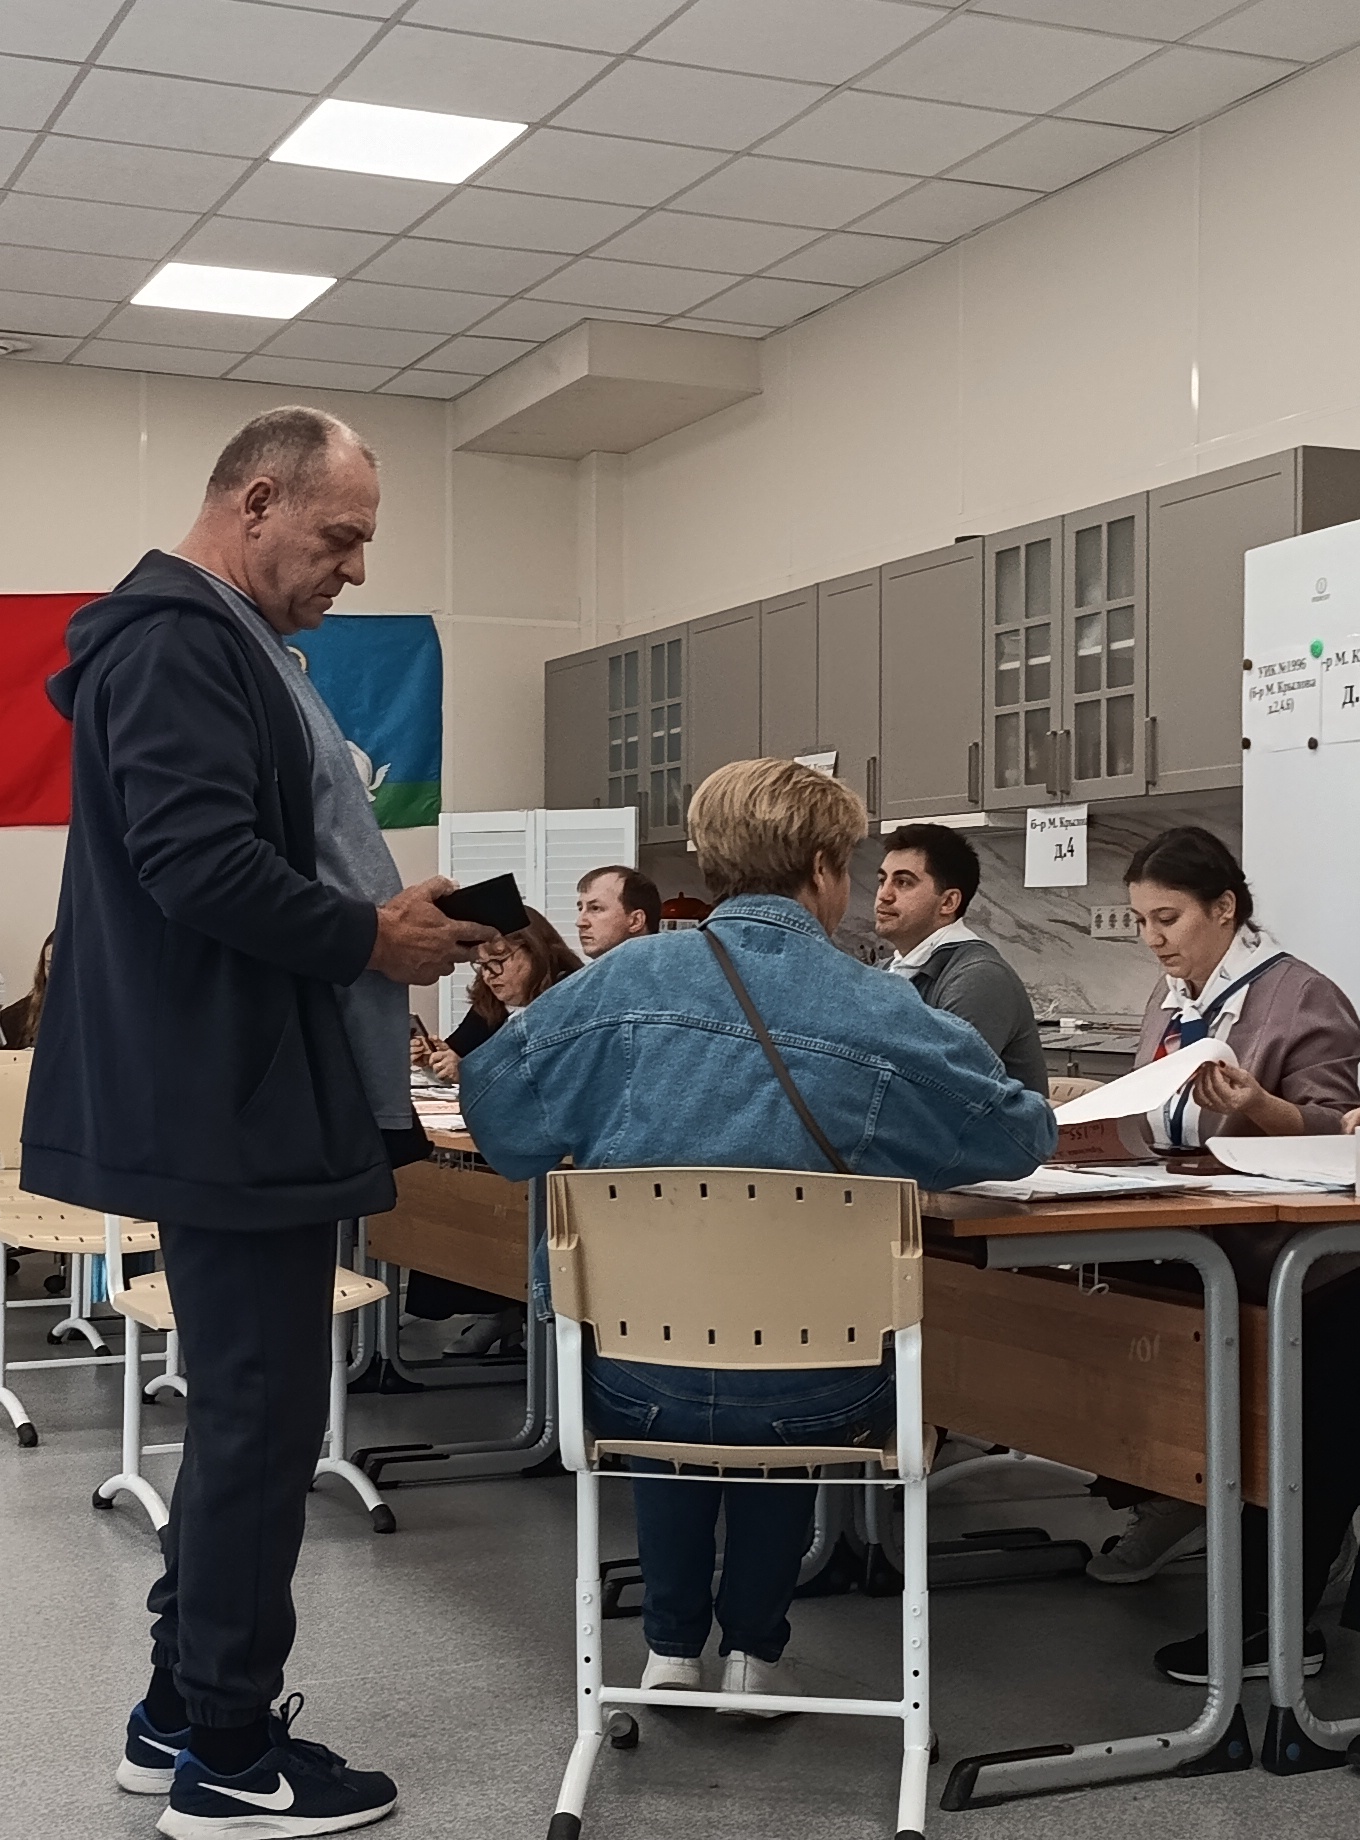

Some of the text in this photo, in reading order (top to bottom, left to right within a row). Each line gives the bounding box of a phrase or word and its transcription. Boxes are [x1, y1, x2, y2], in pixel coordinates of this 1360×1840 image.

[1321, 657, 1333, 672] -р
[1334, 650, 1349, 666] М.
[1277, 678, 1317, 696] Крылова
[1030, 818, 1046, 833] б-р
[1054, 836, 1075, 862] д.4
